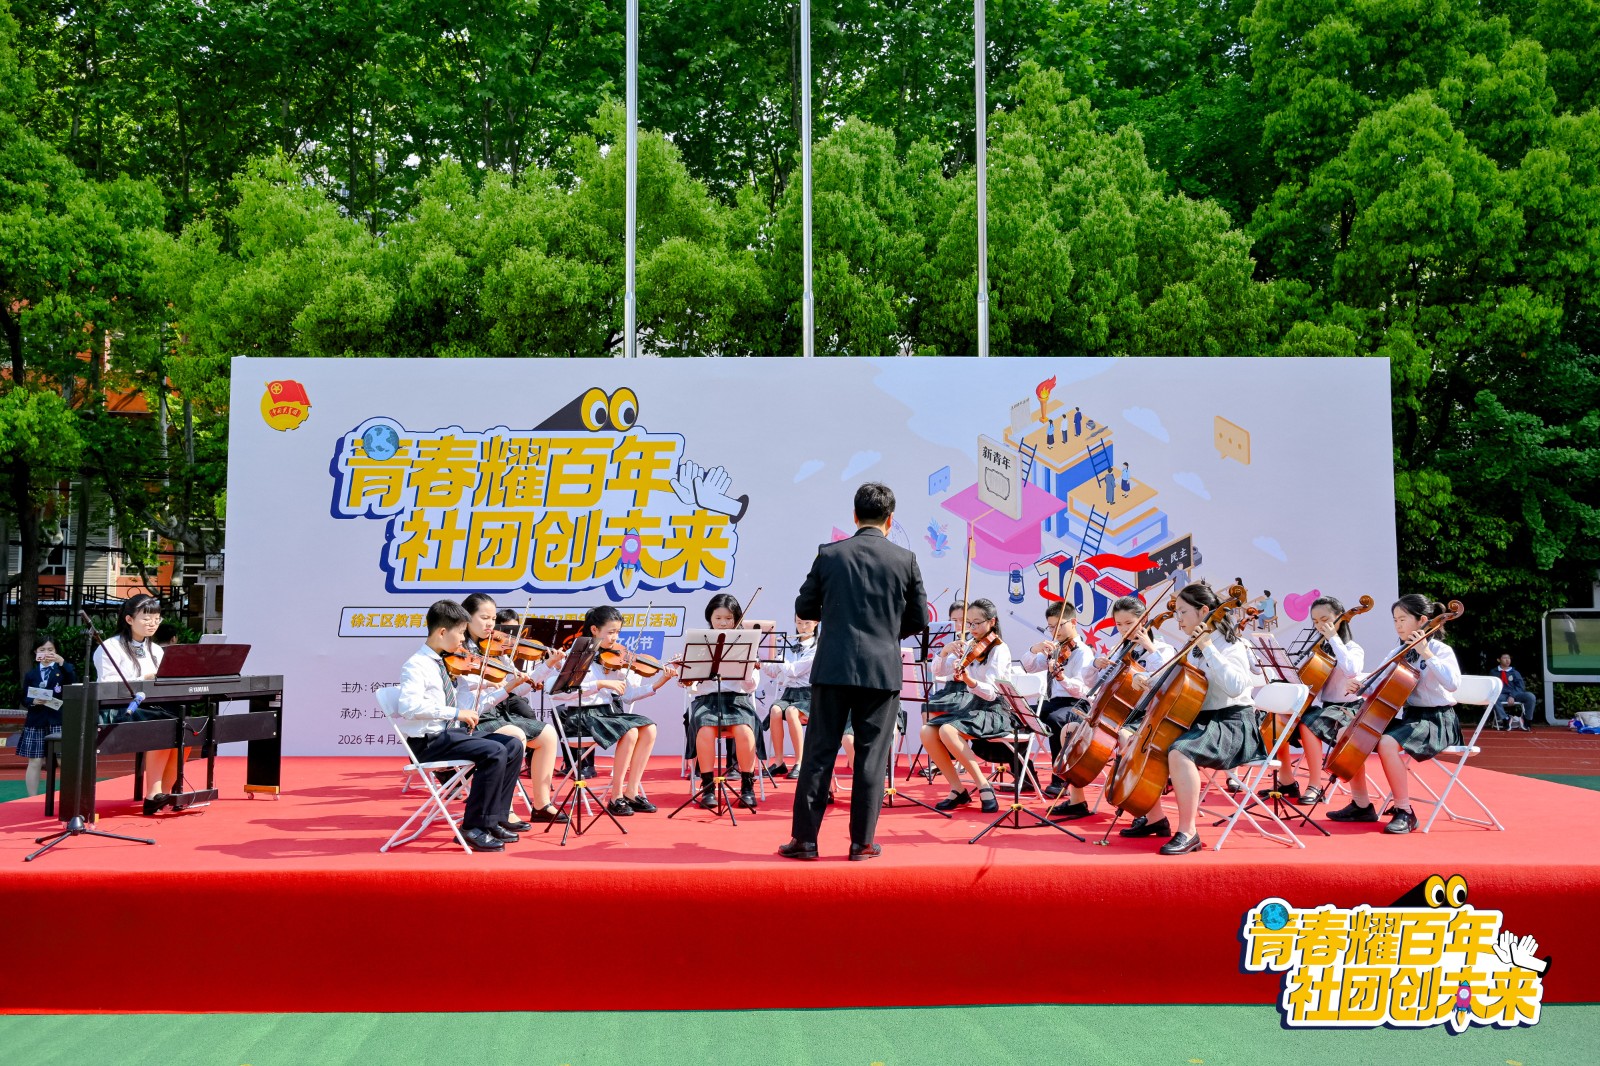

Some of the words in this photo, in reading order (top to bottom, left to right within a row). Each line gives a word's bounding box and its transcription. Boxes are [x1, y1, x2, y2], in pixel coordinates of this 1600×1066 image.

[347, 434, 677, 507] 青春耀百年
[982, 446, 1012, 470] 新青年
[396, 508, 730, 582] 社团创未来
[350, 613, 428, 629] 徐汇区教育
[621, 613, 678, 628] 团日活动
